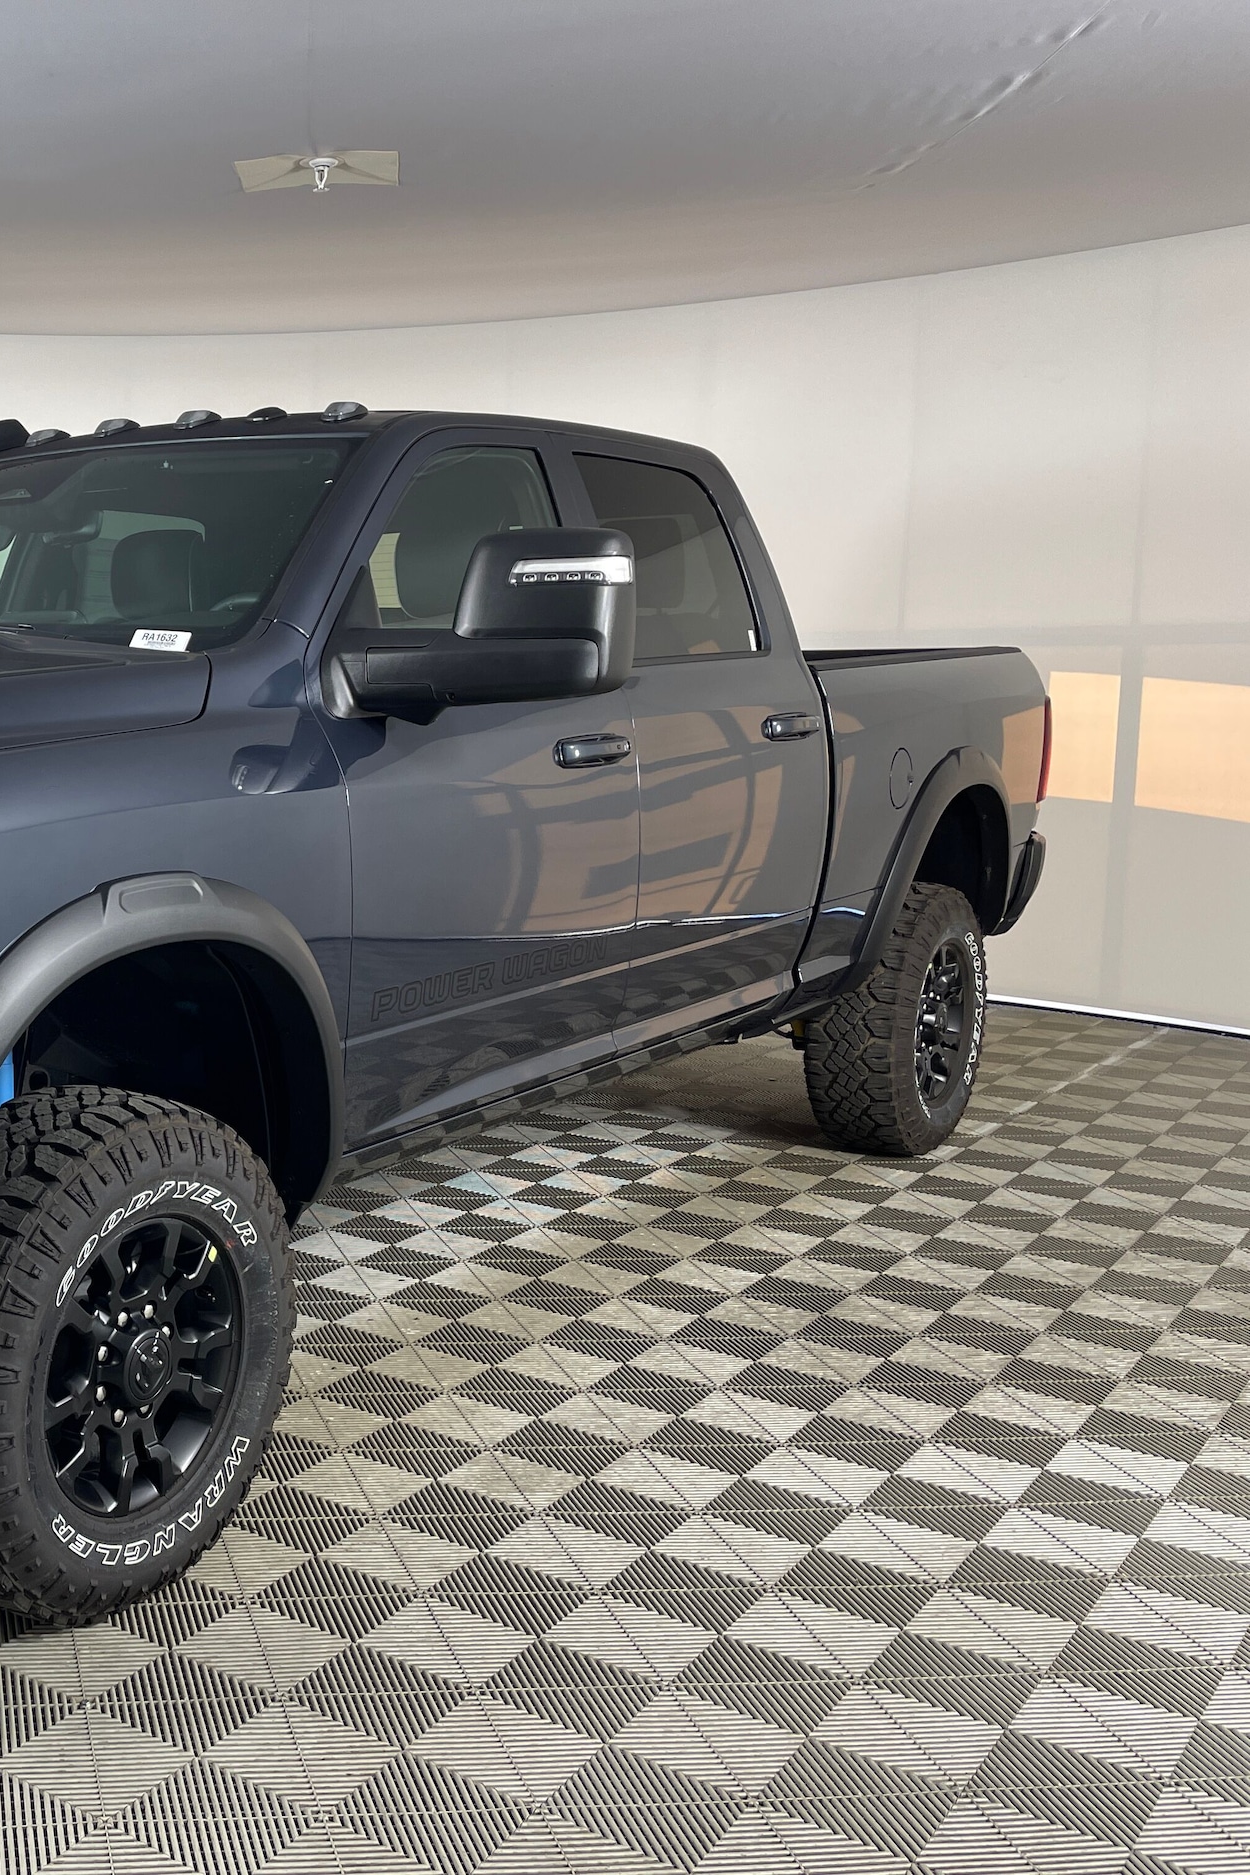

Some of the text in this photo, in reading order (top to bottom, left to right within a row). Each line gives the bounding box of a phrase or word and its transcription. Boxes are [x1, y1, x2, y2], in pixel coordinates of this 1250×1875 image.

[141, 632, 178, 643] RA1632
[370, 938, 609, 1022] POWER WAGON
[964, 931, 983, 1086] GOODYEAR
[55, 1179, 259, 1307] GOODYEAR
[52, 1435, 251, 1566] WRANGLER
